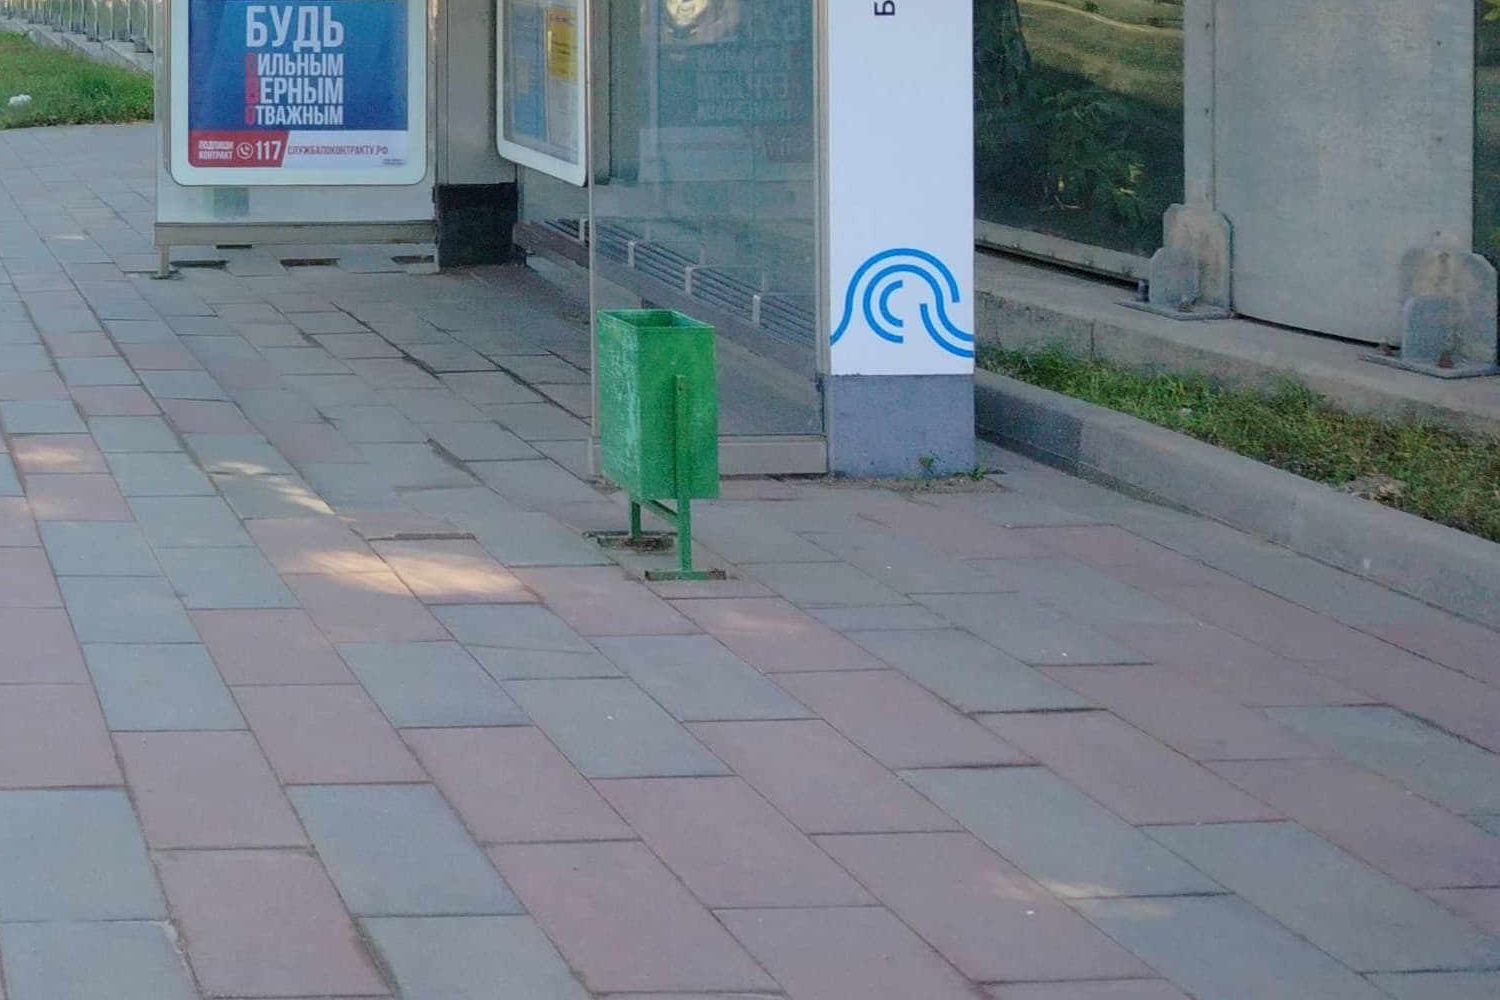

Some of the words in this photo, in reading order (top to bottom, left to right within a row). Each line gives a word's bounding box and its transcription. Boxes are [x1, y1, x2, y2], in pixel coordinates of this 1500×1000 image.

[246, 5, 344, 53] БУДЬ
[244, 104, 344, 126] ОТВАЖНЫМ
[256, 140, 282, 161] 117
